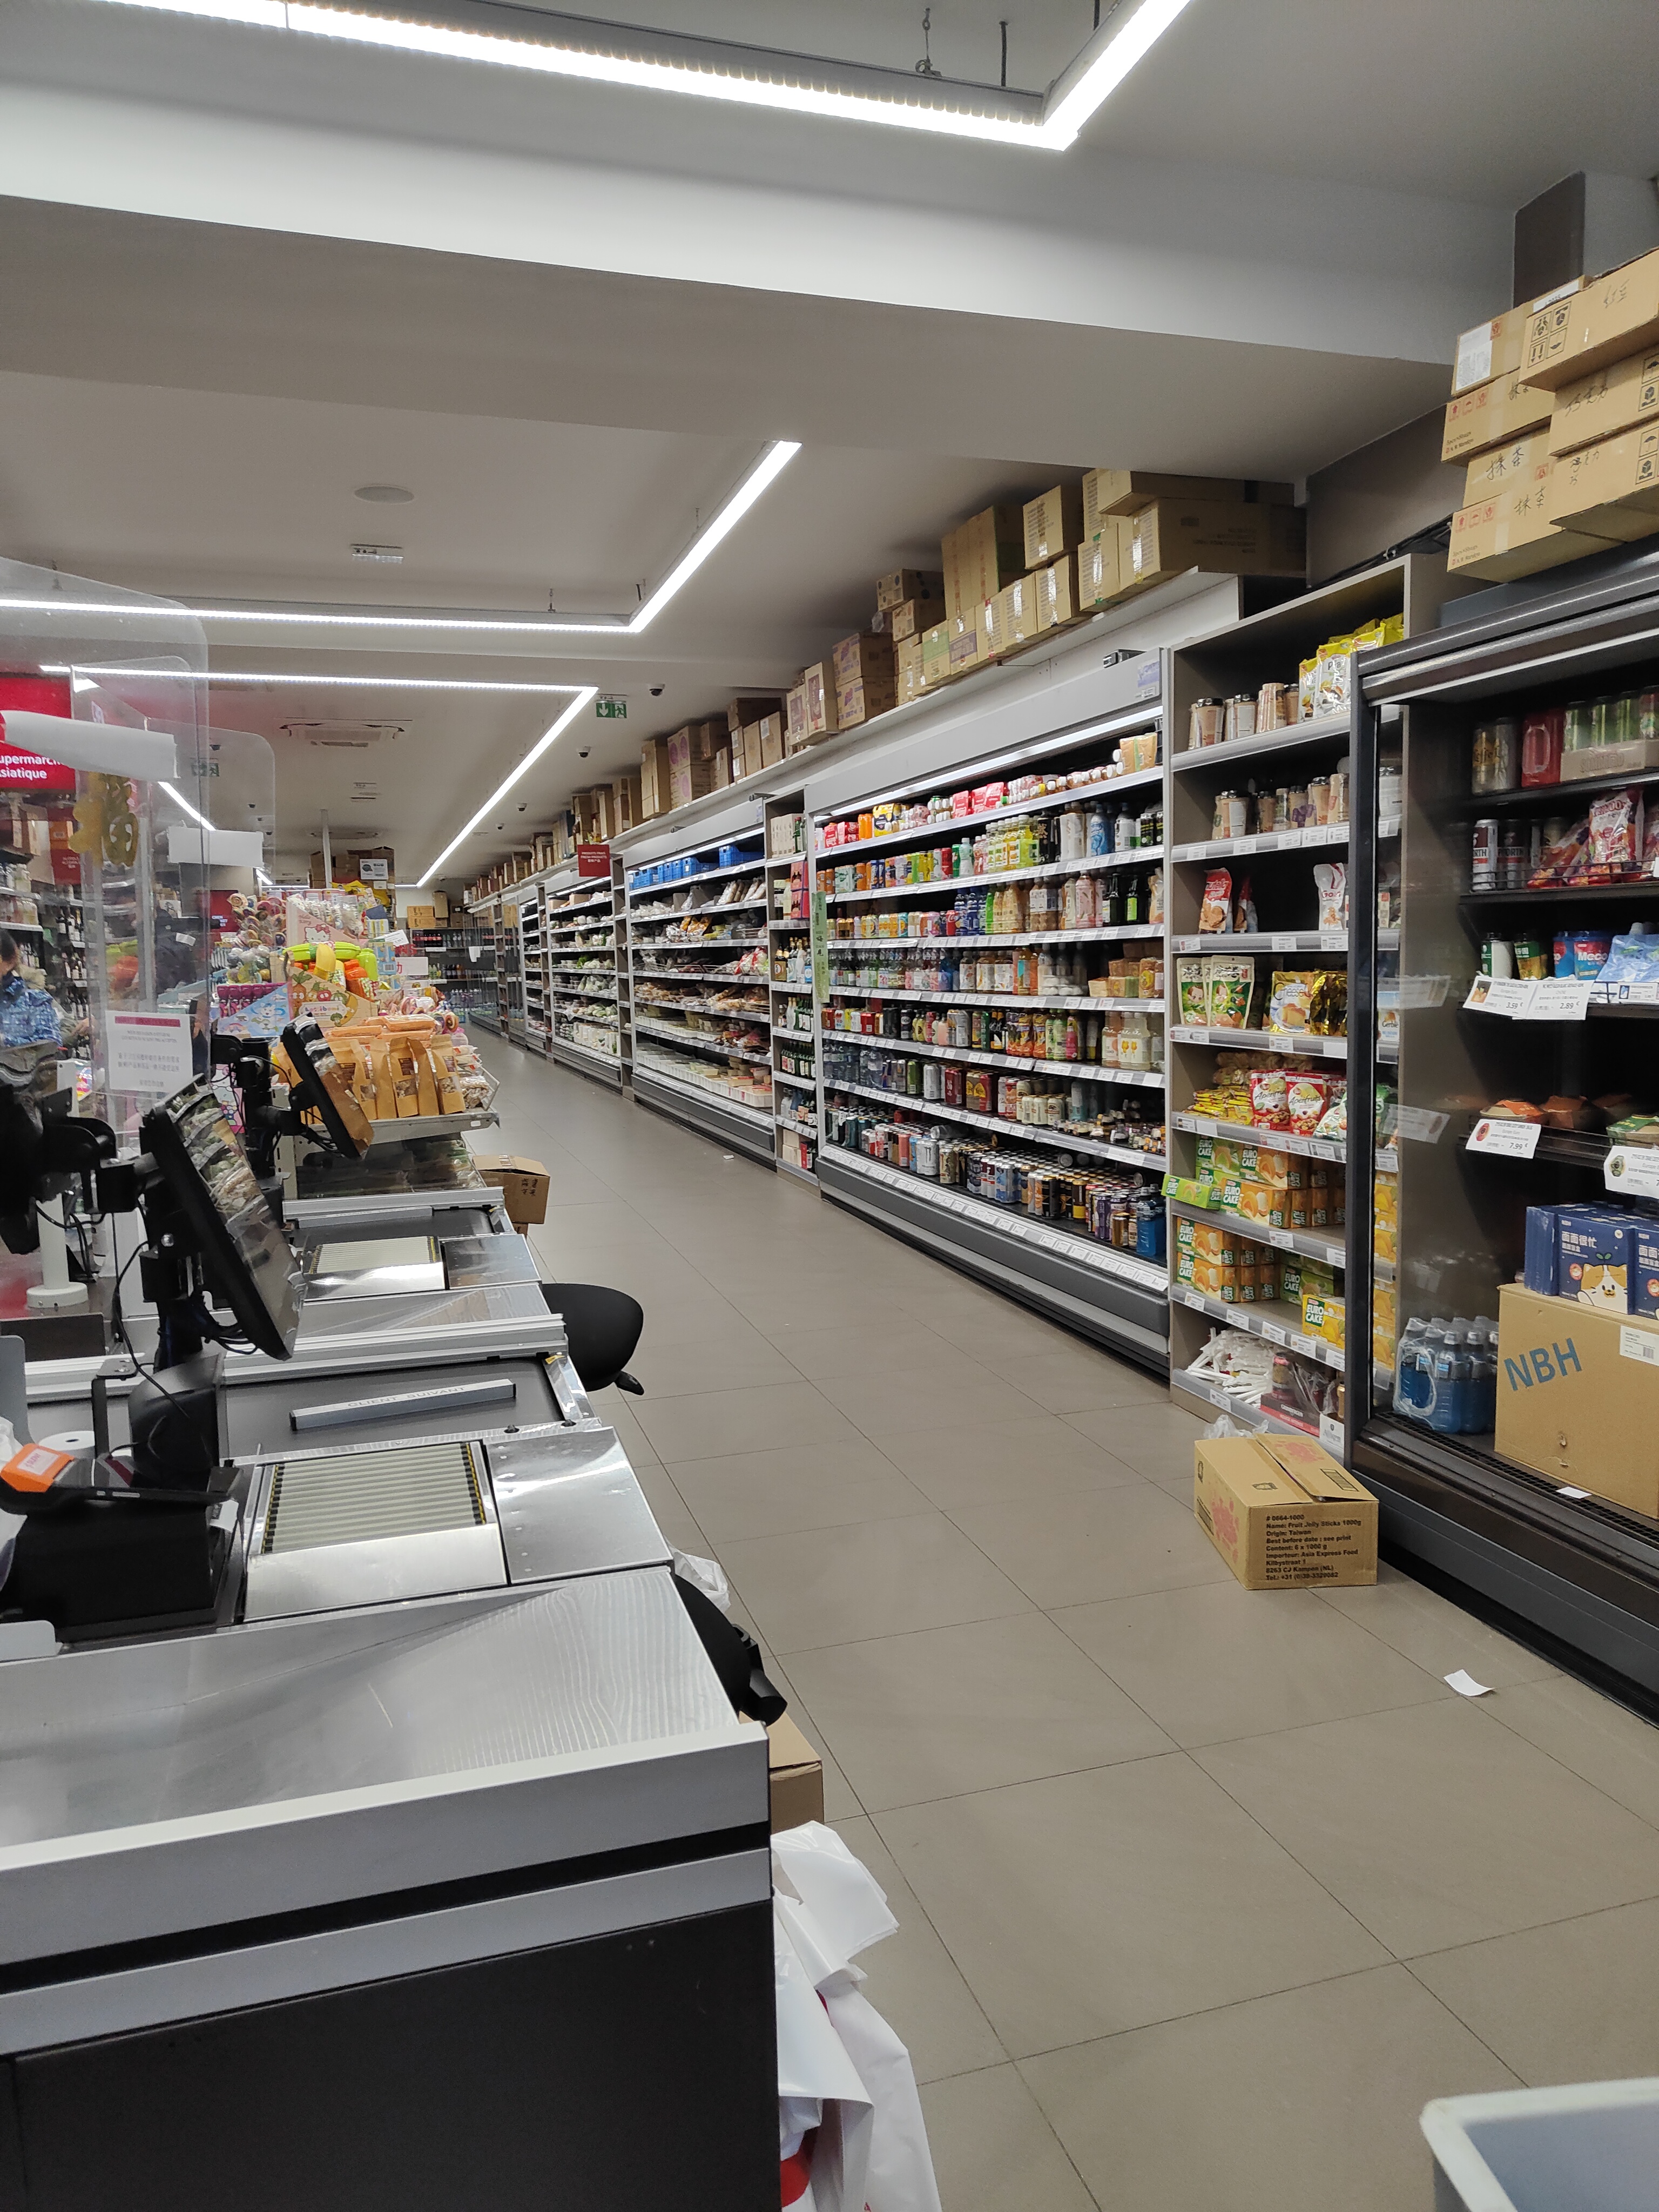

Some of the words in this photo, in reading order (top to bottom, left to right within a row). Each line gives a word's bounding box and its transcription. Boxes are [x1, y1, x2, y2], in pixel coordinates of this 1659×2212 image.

[0, 756, 64, 766] upermarc
[0, 767, 48, 781] siatique
[1577, 952, 1608, 961] Meco
[1199, 1139, 1212, 1148] EURO
[1198, 1148, 1212, 1156] CAKE
[1242, 1150, 1257, 1158] EURO
[1242, 1158, 1257, 1166] CAKE
[1224, 1186, 1240, 1195] EURO
[1223, 1195, 1239, 1204] CAKE
[1180, 1225, 1194, 1234] EURO
[1179, 1233, 1193, 1242] CAKE
[1180, 1260, 1194, 1269] EURO
[1179, 1269, 1193, 1277] CAKE
[1285, 1273, 1300, 1283] EURO
[1284, 1282, 1299, 1291] CAKE
[1307, 1304, 1324, 1316] EURO
[1306, 1313, 1323, 1324] CAKE
[1504, 1338, 1582, 1391] NBH
